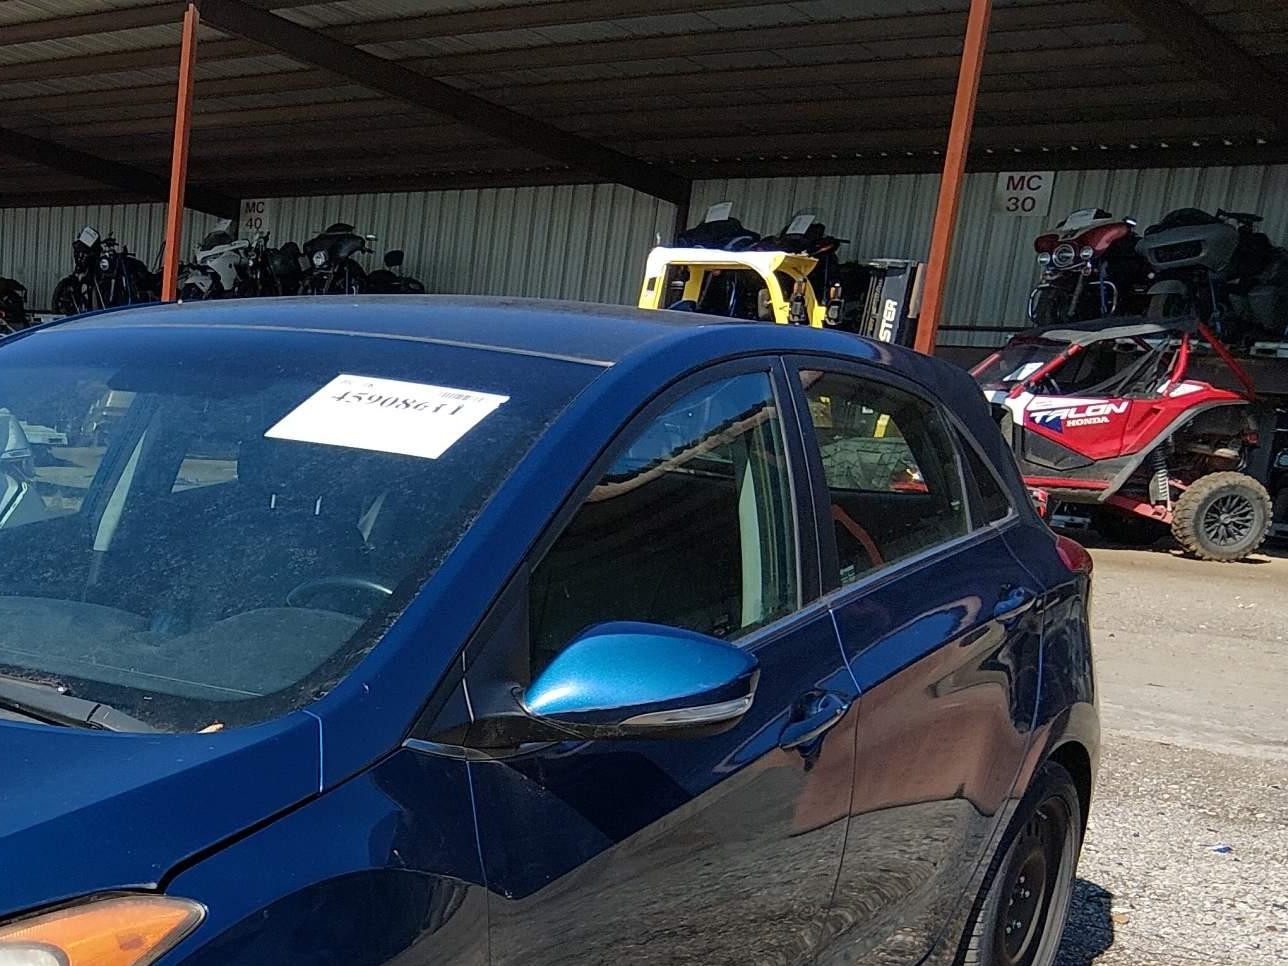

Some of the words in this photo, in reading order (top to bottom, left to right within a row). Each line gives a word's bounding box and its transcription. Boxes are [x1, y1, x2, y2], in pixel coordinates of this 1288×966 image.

[1006, 174, 1043, 191] MC
[245, 201, 265, 213] MC
[1006, 196, 1036, 213] 30
[246, 217, 263, 230] 40
[1029, 400, 1130, 424] TALON
[1066, 416, 1110, 427] HONDA
